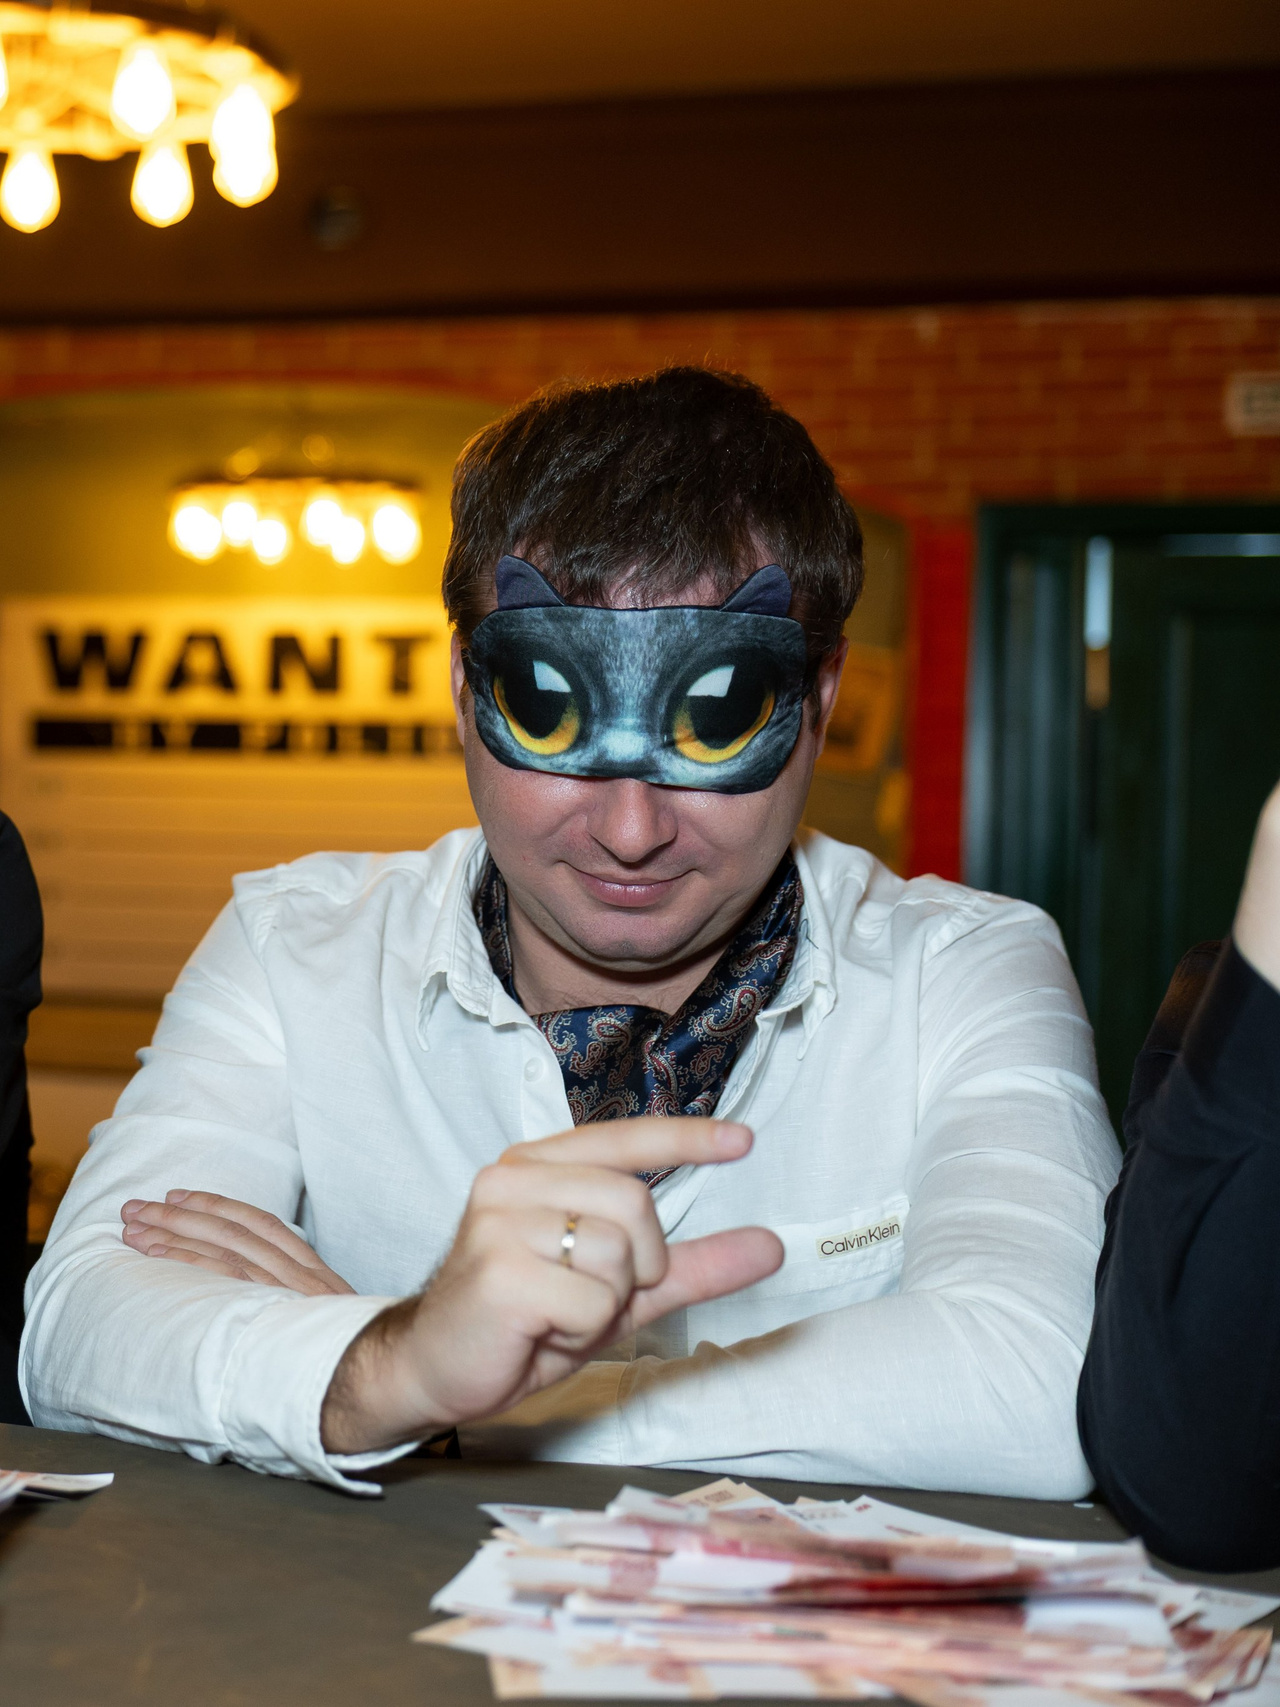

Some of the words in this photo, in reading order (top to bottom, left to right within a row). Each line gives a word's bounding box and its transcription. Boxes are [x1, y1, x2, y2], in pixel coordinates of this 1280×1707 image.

[42, 627, 434, 696] WANT
[820, 1234, 868, 1256] Calvin
[868, 1222, 901, 1243] Klein
